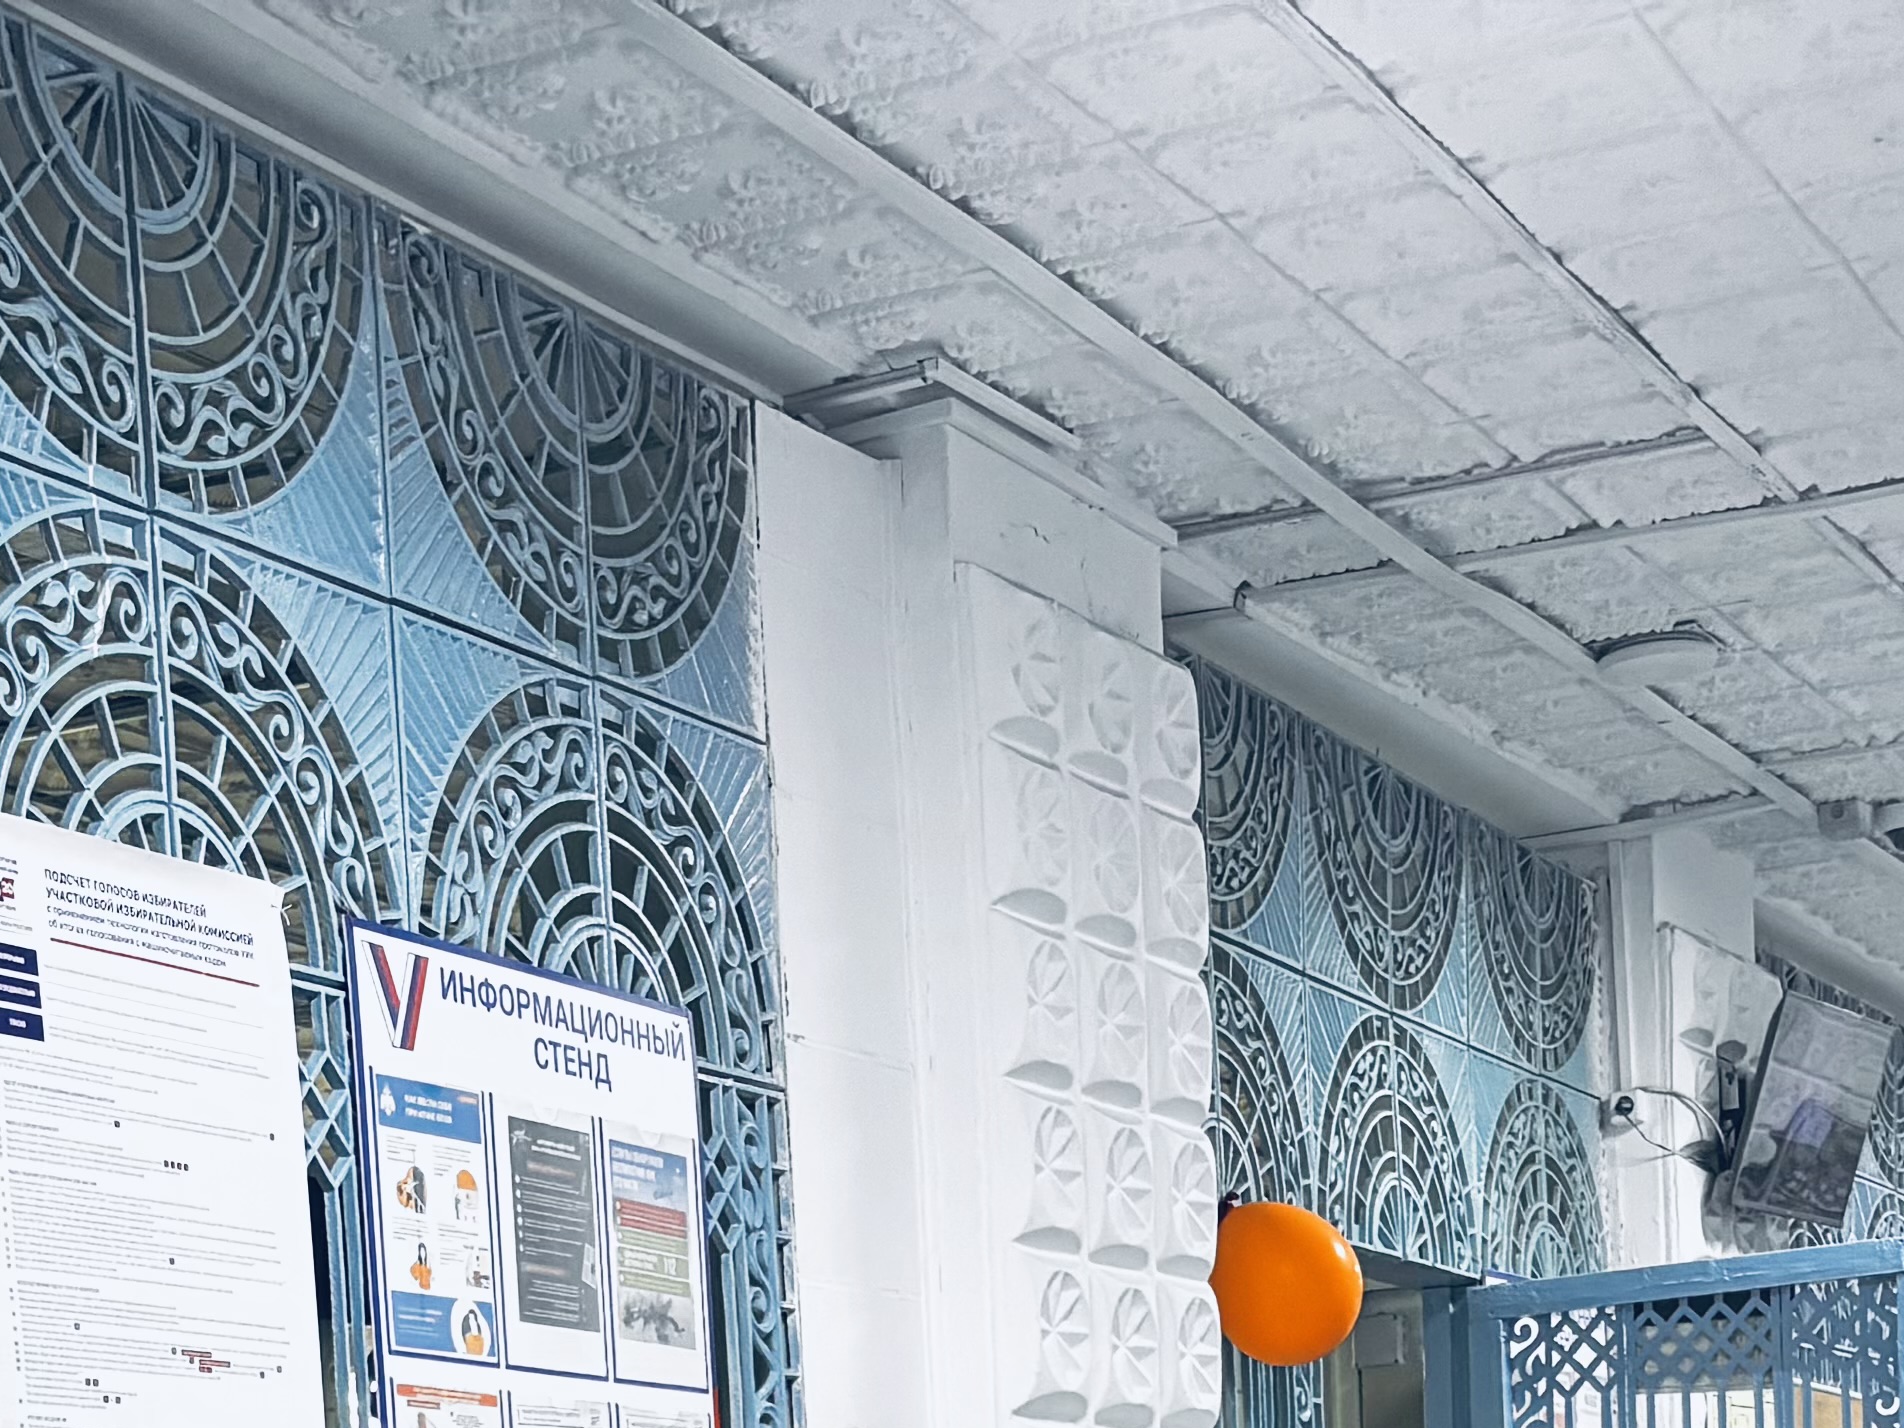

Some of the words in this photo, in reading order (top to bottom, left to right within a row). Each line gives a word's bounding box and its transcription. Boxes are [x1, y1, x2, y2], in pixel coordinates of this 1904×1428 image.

[44, 868, 90, 888] ПОДСЧЕТ
[93, 880, 140, 901] ГОЛОСОВ
[141, 893, 206, 917] ИЗБИРАТЕЛЕЙ
[45, 887, 114, 912] УЧАСТКОВОЙ
[116, 903, 196, 932] ИЗБИРАТЕЛЬНОЙ
[198, 924, 253, 945] КОМИССИЕЙ
[440, 966, 686, 1061] ИНФОРМАЦИОННЫЙ
[534, 1037, 612, 1092] СТЕНД
